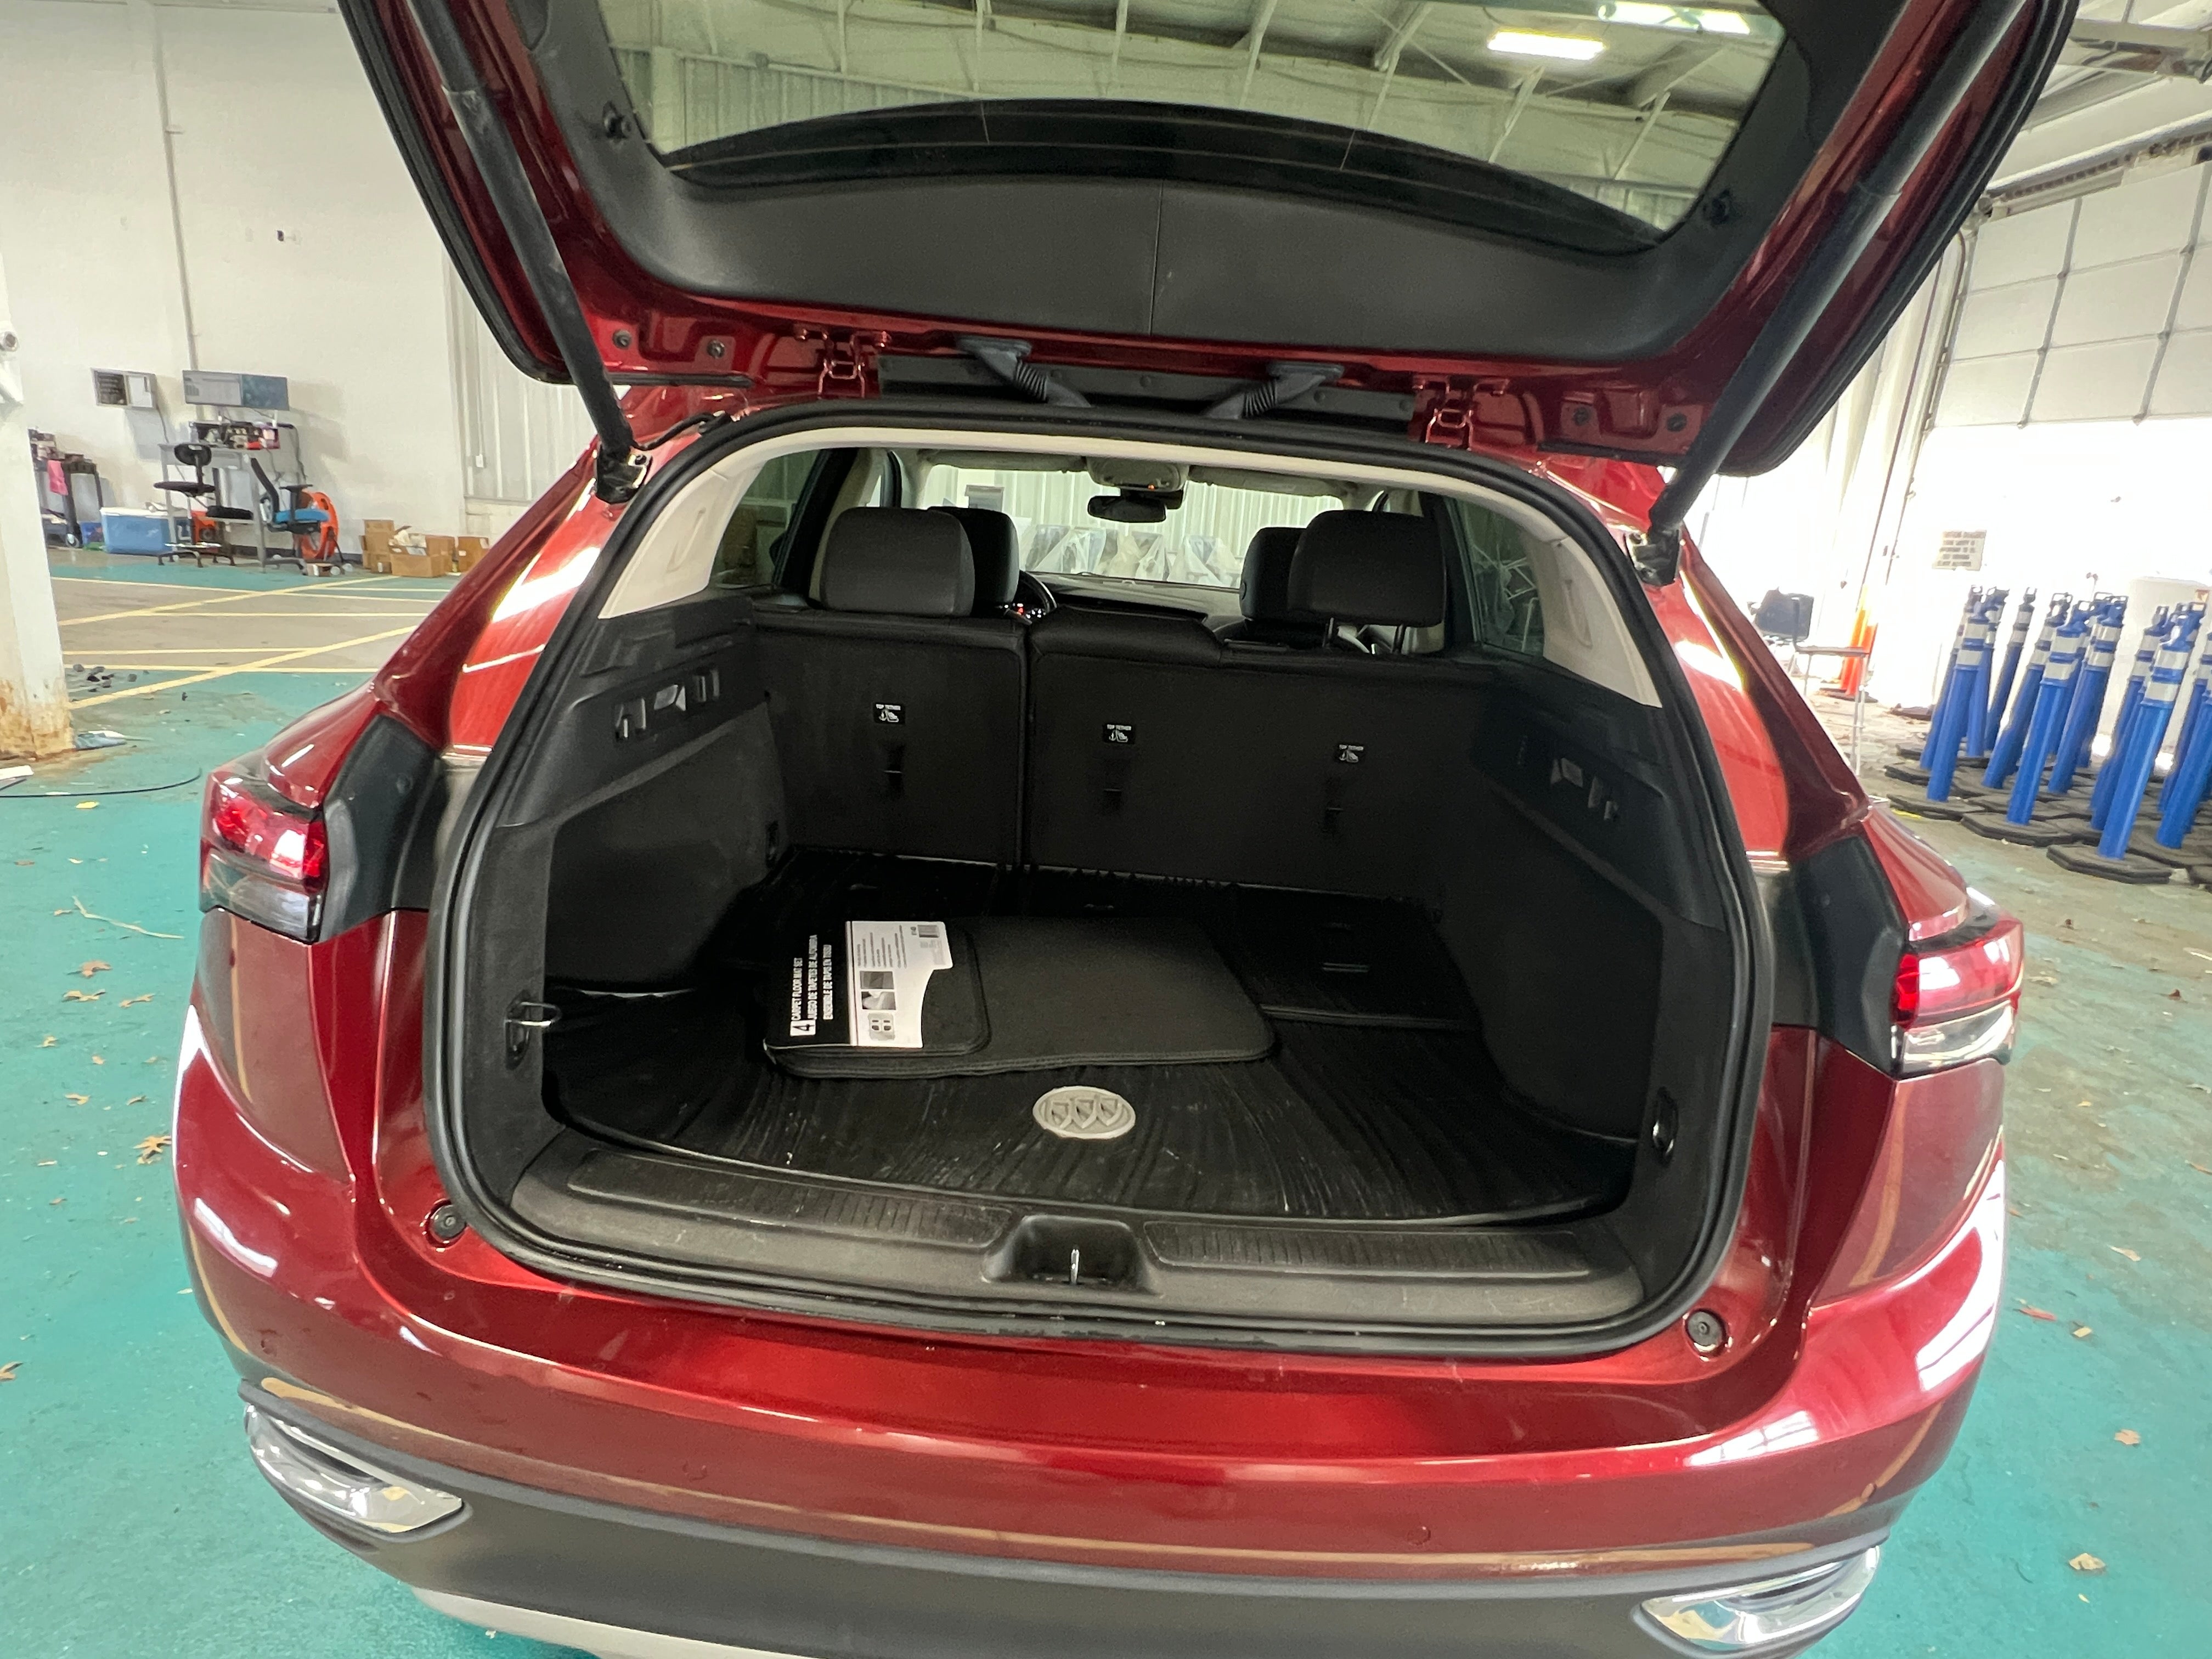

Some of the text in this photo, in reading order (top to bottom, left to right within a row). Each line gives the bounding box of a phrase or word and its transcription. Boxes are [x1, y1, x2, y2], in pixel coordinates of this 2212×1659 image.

[791, 958, 803, 1020] CARPET FLOOR MAT SET
[808, 969, 817, 991] TAPETES
[808, 1000, 817, 1019] JUEGO
